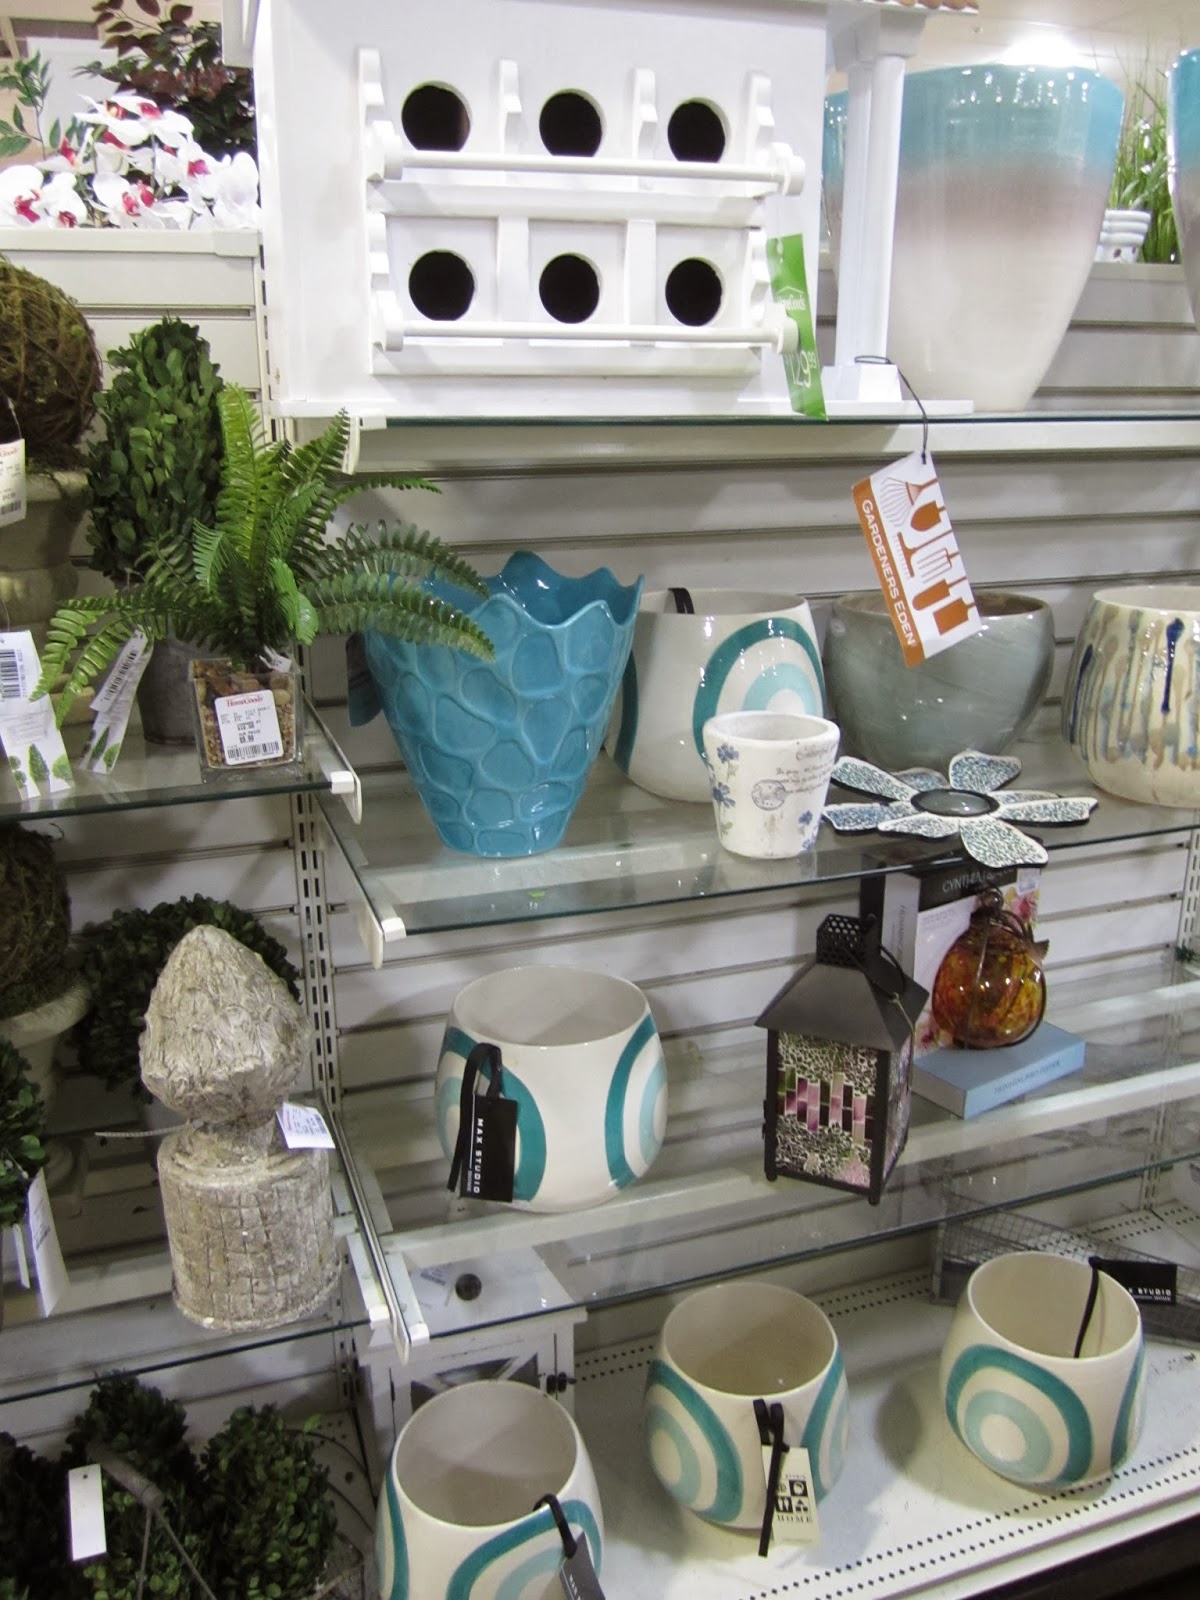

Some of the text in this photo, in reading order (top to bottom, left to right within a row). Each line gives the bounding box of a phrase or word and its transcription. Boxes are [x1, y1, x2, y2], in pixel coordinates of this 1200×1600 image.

[861, 499, 917, 648] GARDENERS EDEN
[227, 695, 263, 708] HomeGoods
[473, 1117, 484, 1194] MAX STUDIO
[1137, 1287, 1172, 1296] STUDIO
